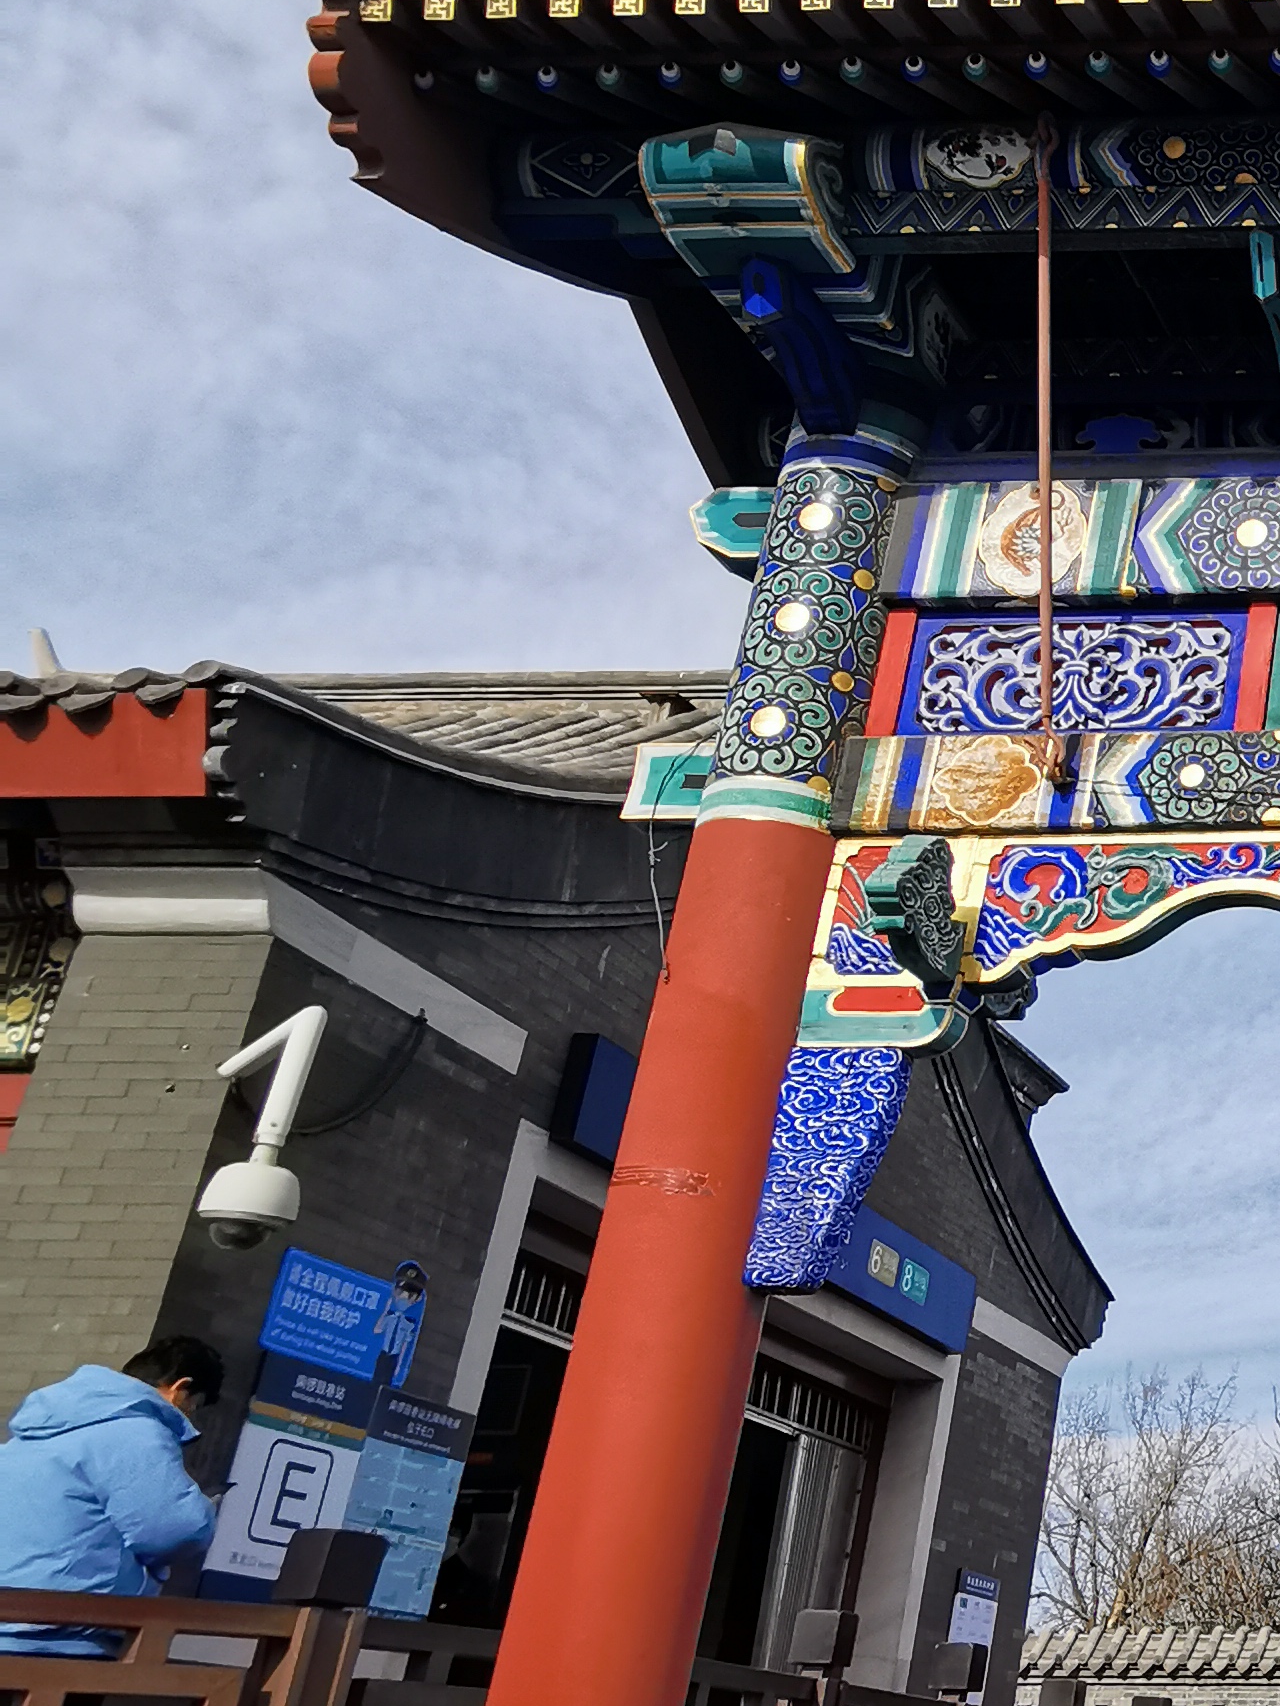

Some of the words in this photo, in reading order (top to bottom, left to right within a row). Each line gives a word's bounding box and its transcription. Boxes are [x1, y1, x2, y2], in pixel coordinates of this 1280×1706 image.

[871, 1245, 883, 1274] 6
[901, 1264, 913, 1292] 8
[270, 1460, 317, 1530] E
